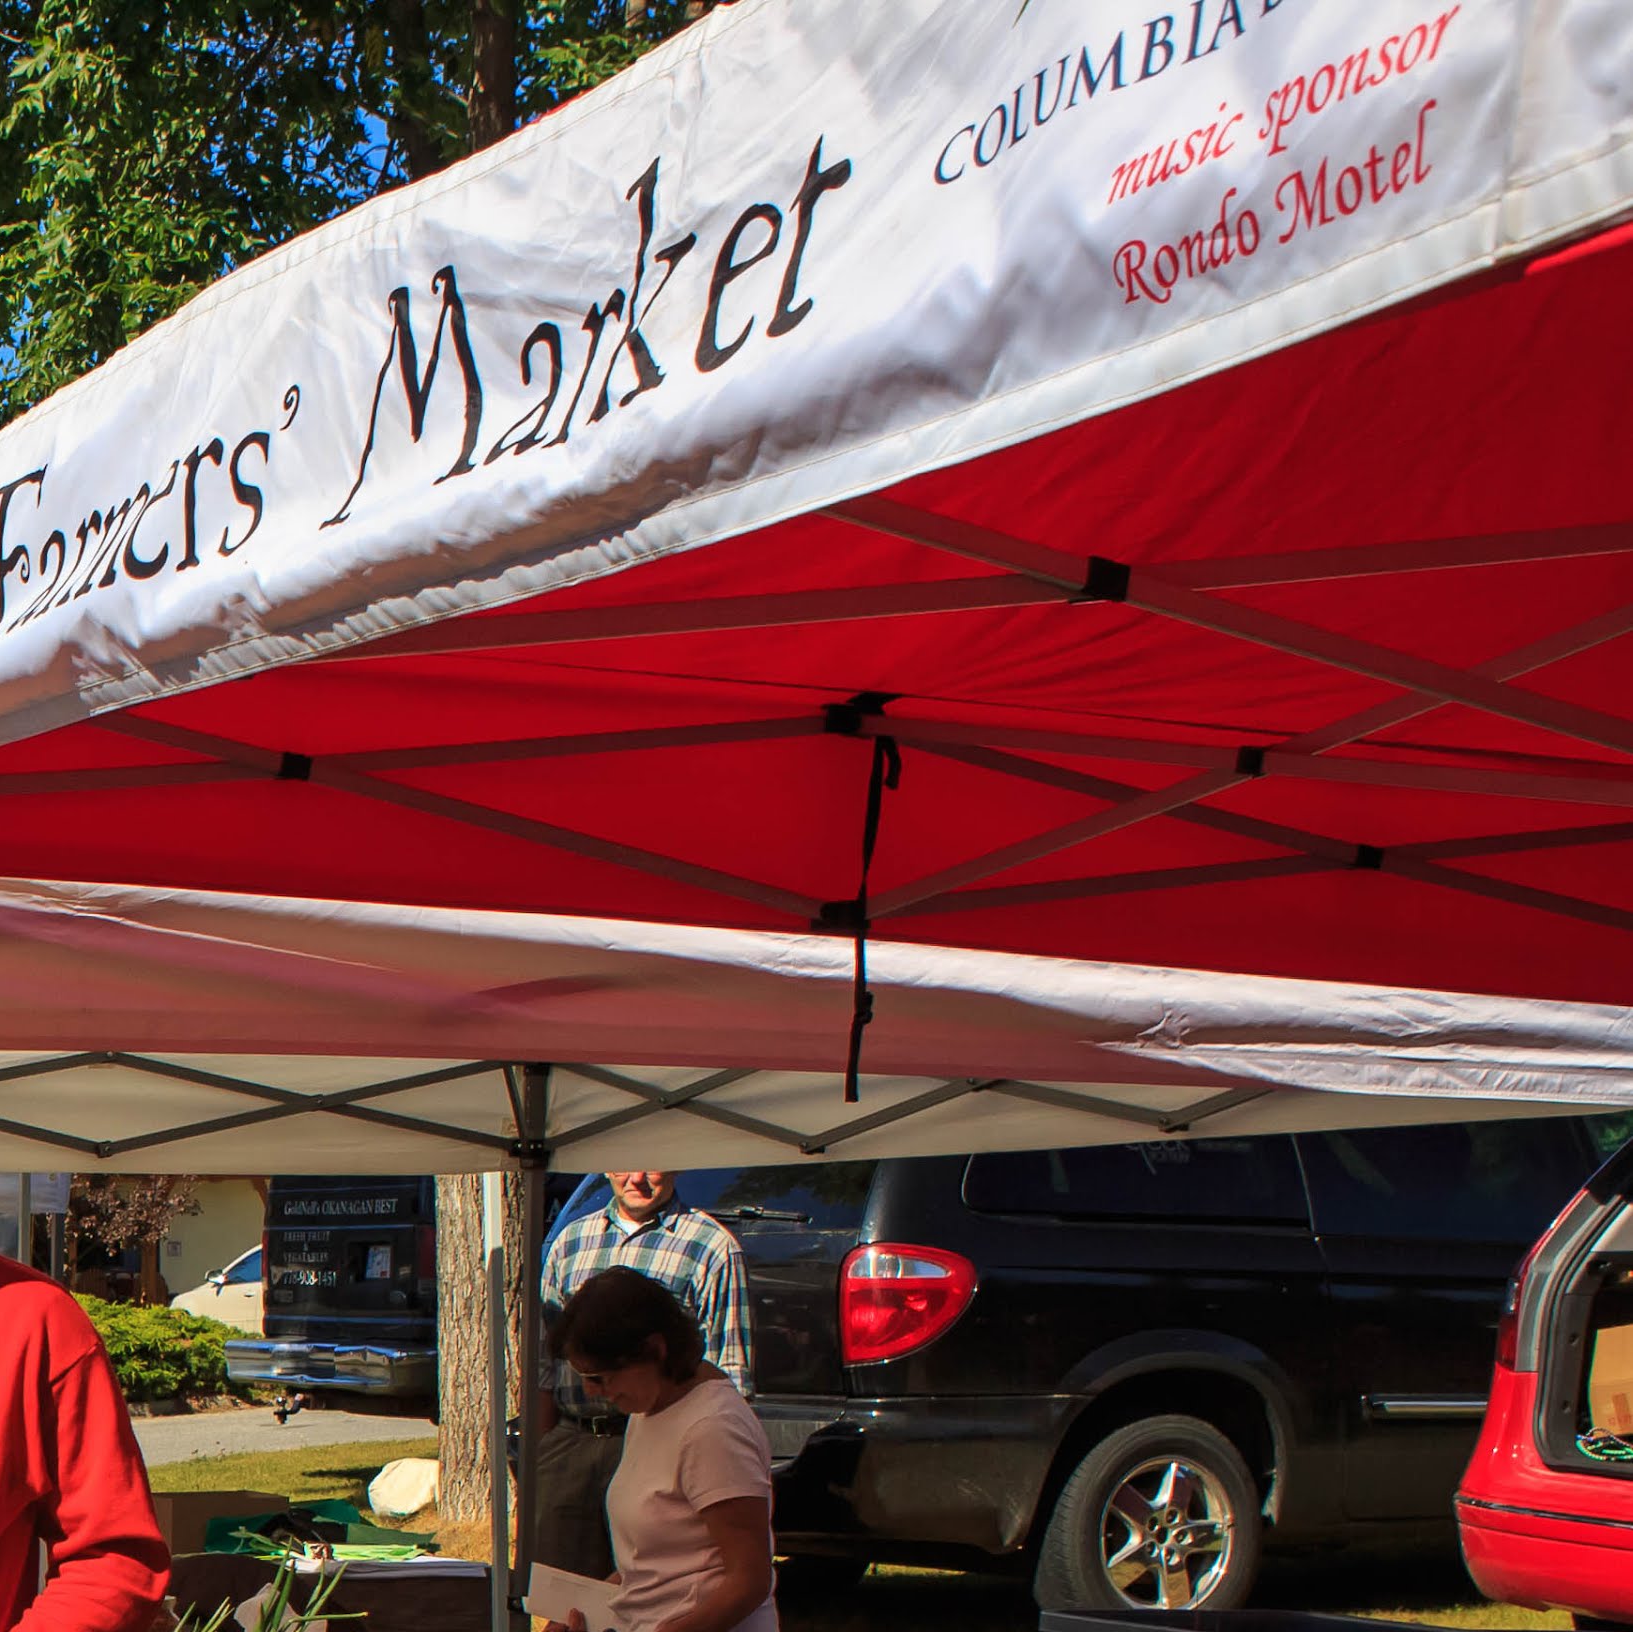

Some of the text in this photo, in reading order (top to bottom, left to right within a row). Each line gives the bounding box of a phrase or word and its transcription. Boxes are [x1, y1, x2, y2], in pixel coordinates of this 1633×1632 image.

[934, 0, 1246, 186] COLUMBIA
[1108, 4, 1461, 204] music sponsor
[1113, 99, 1437, 304] Rondo Motel
[319, 134, 852, 530] Market
[374, 1198, 398, 1214] BEST
